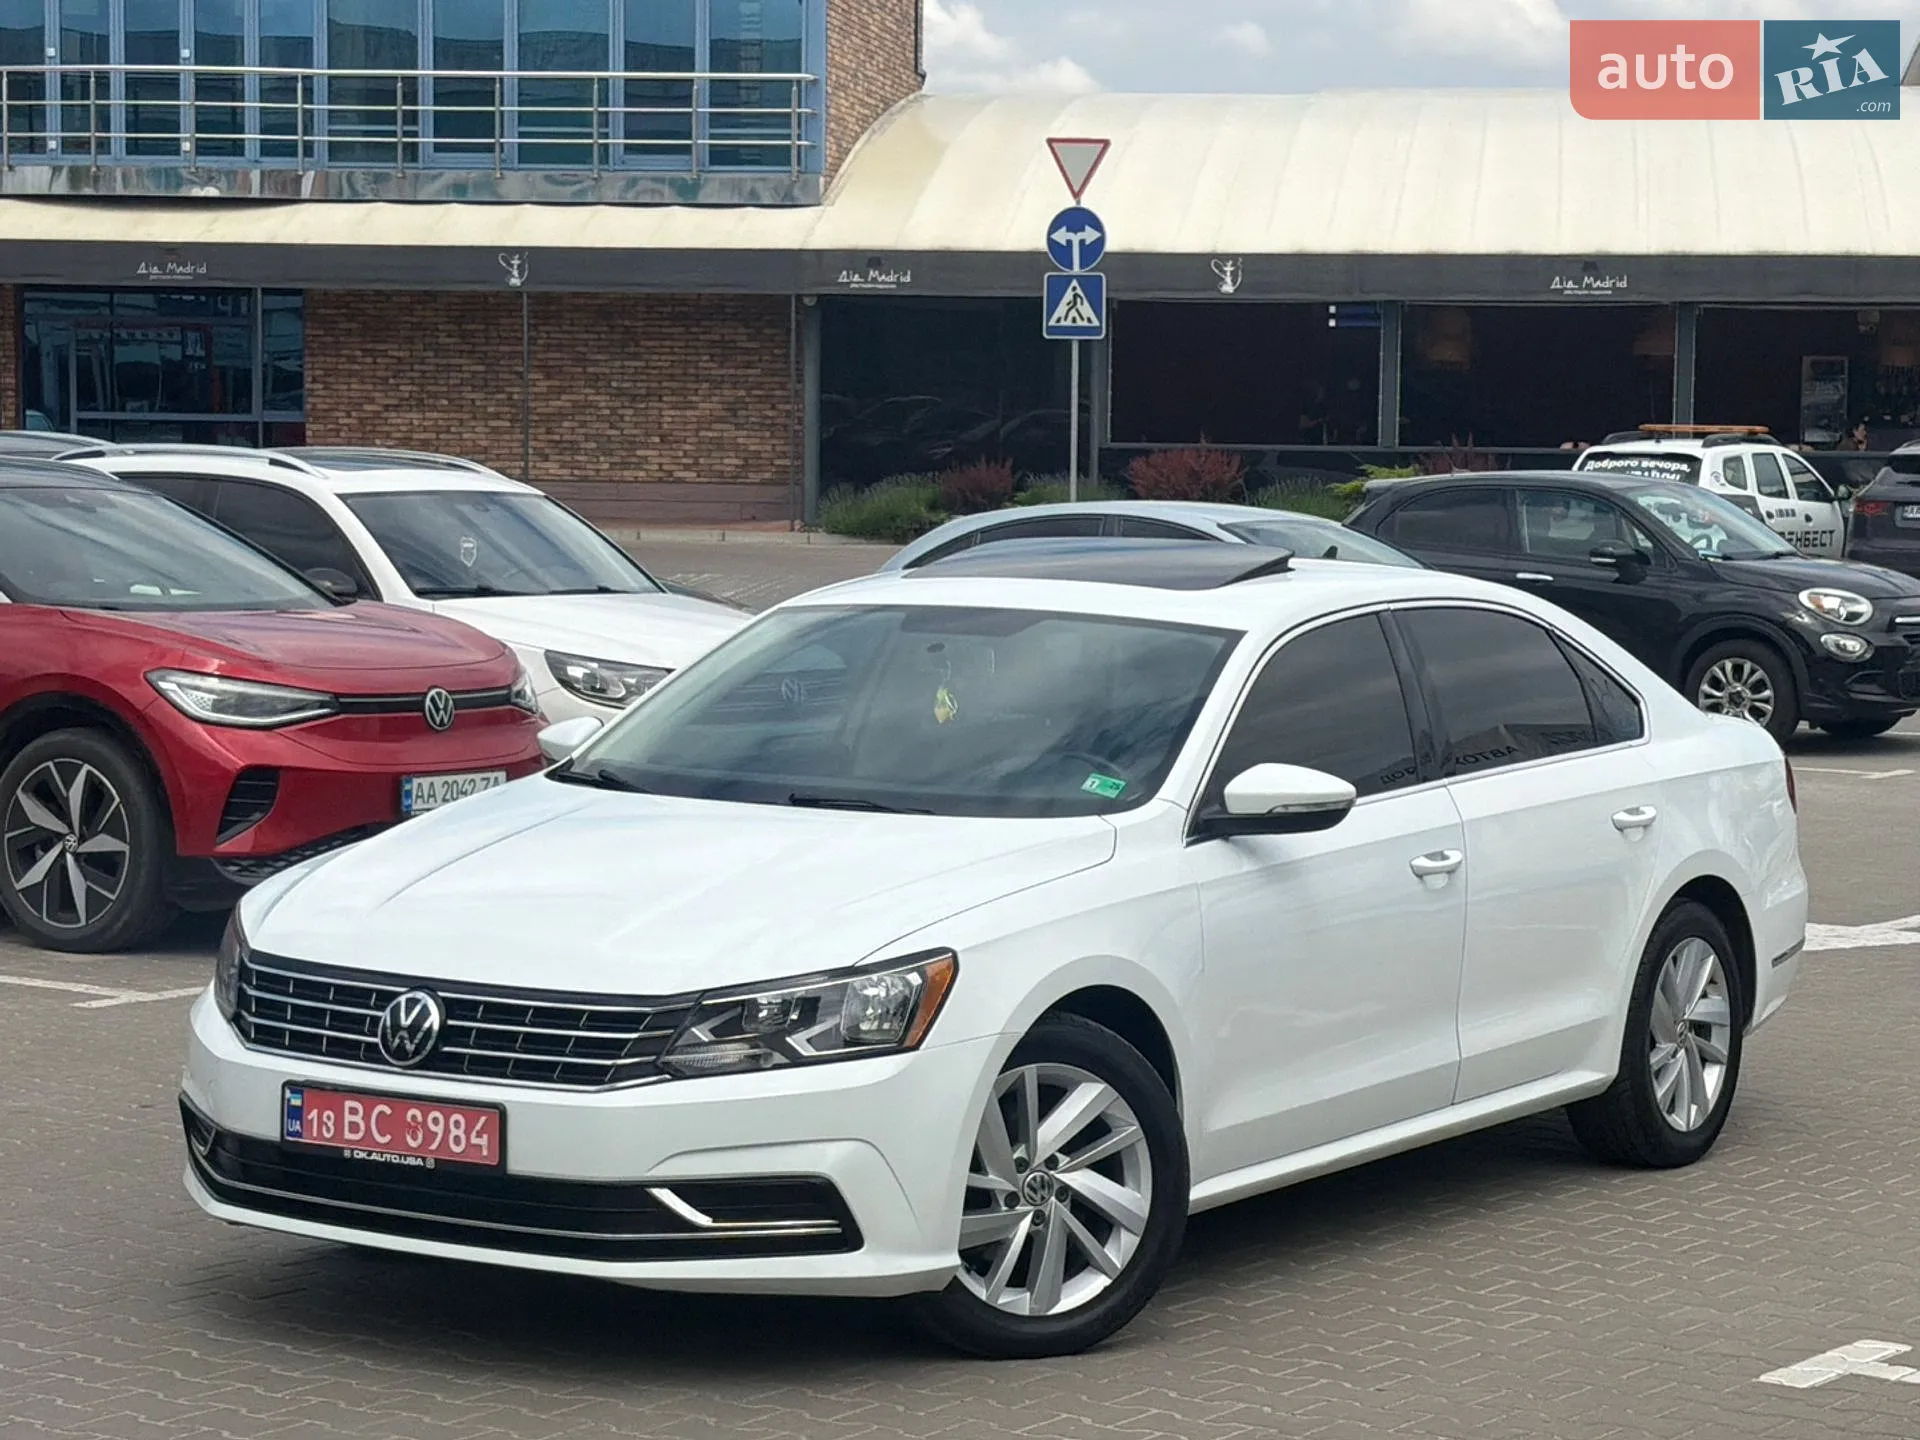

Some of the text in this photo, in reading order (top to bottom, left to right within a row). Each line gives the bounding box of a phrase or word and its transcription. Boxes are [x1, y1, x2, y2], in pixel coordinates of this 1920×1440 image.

[166, 260, 207, 274] Madrid
[867, 268, 912, 283] Madrid
[1582, 274, 1628, 289] Madrid
[1584, 459, 1639, 472] Доброго
[415, 781, 438, 804] AA
[288, 1119, 301, 1132] UA
[343, 1100, 392, 1144] BC
